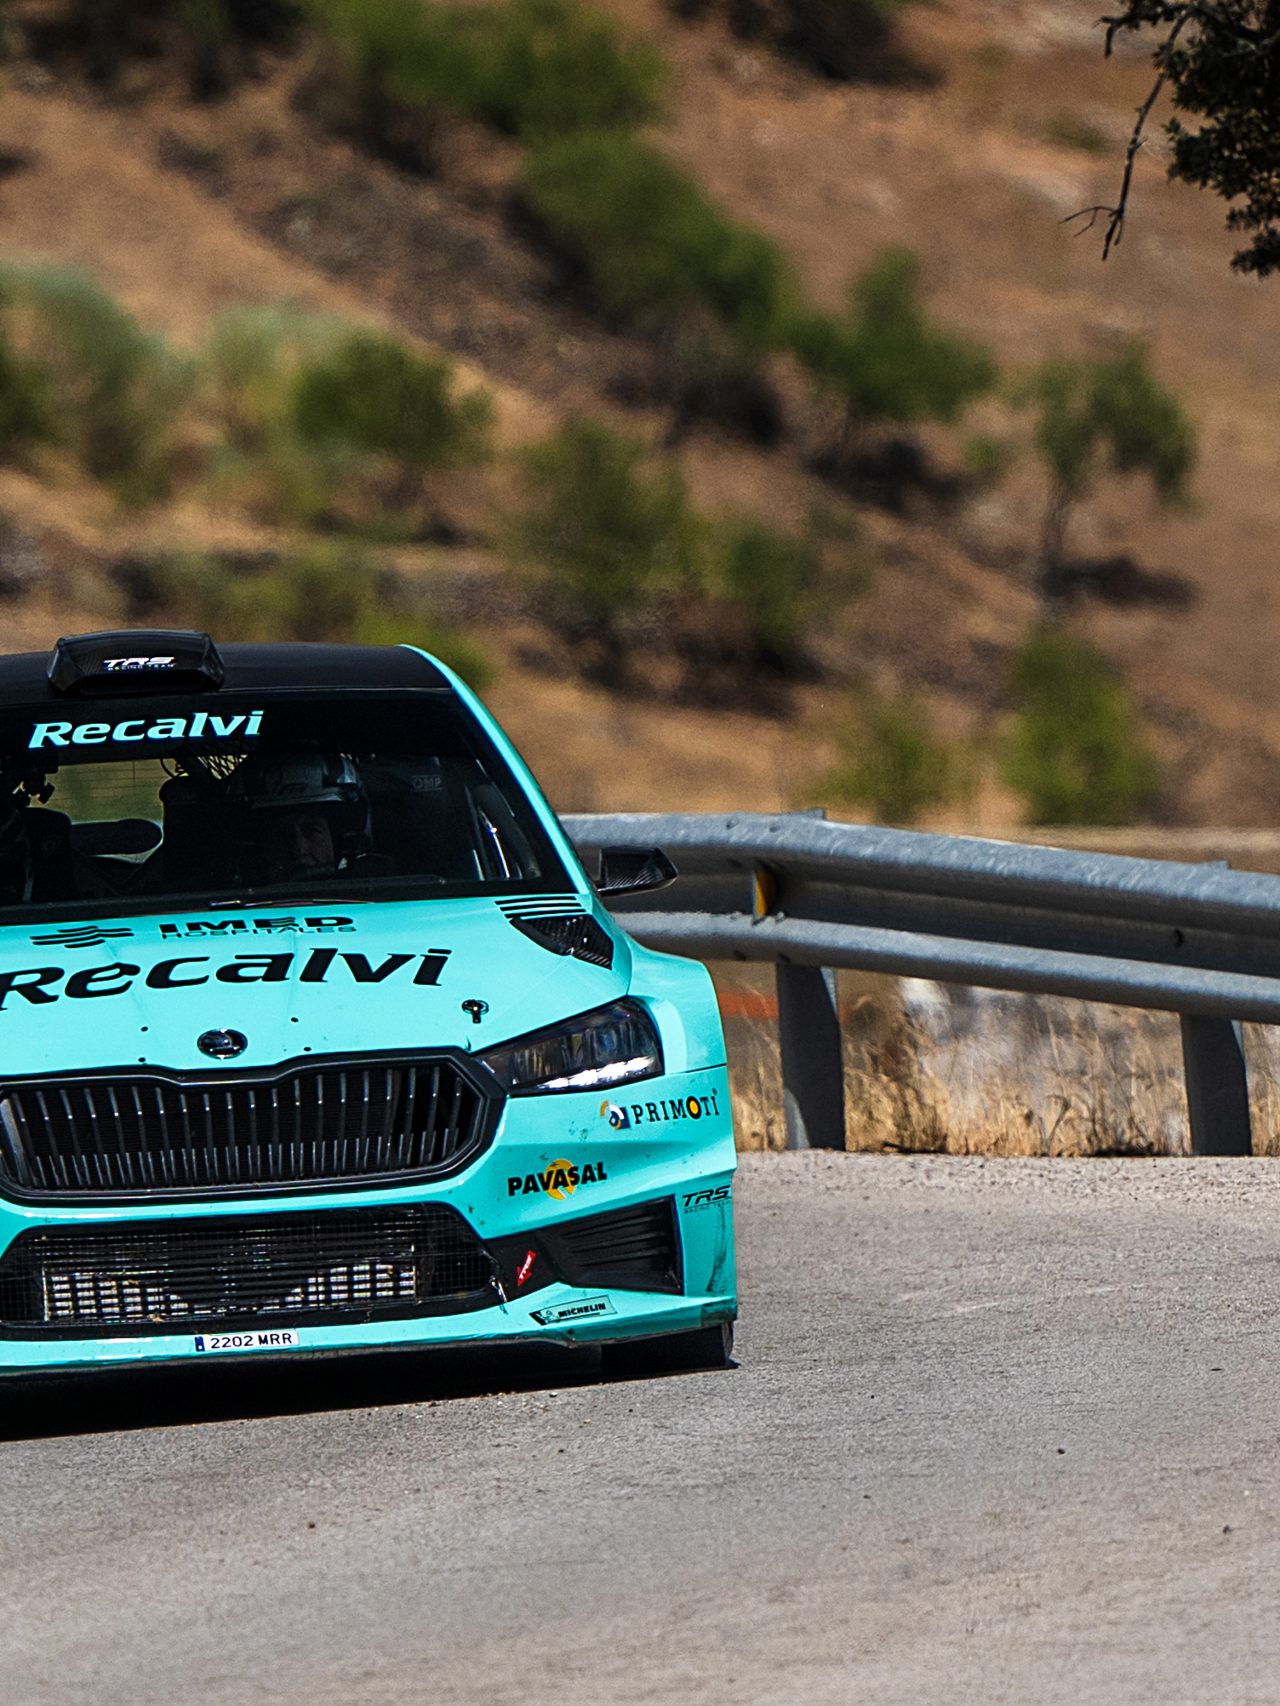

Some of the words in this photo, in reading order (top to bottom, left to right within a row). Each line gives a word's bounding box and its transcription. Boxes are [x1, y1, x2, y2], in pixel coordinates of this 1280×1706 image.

[104, 656, 177, 668] TRS
[28, 710, 264, 748] Recalvi
[158, 916, 354, 933] IMED
[161, 926, 357, 940] HOSPITALES
[507, 1162, 608, 1197] PAVASAL
[682, 1184, 731, 1207] TRS
[558, 1302, 607, 1318] MICHELIN
[210, 1335, 254, 1349] 2202
[257, 1332, 293, 1346] MRR
